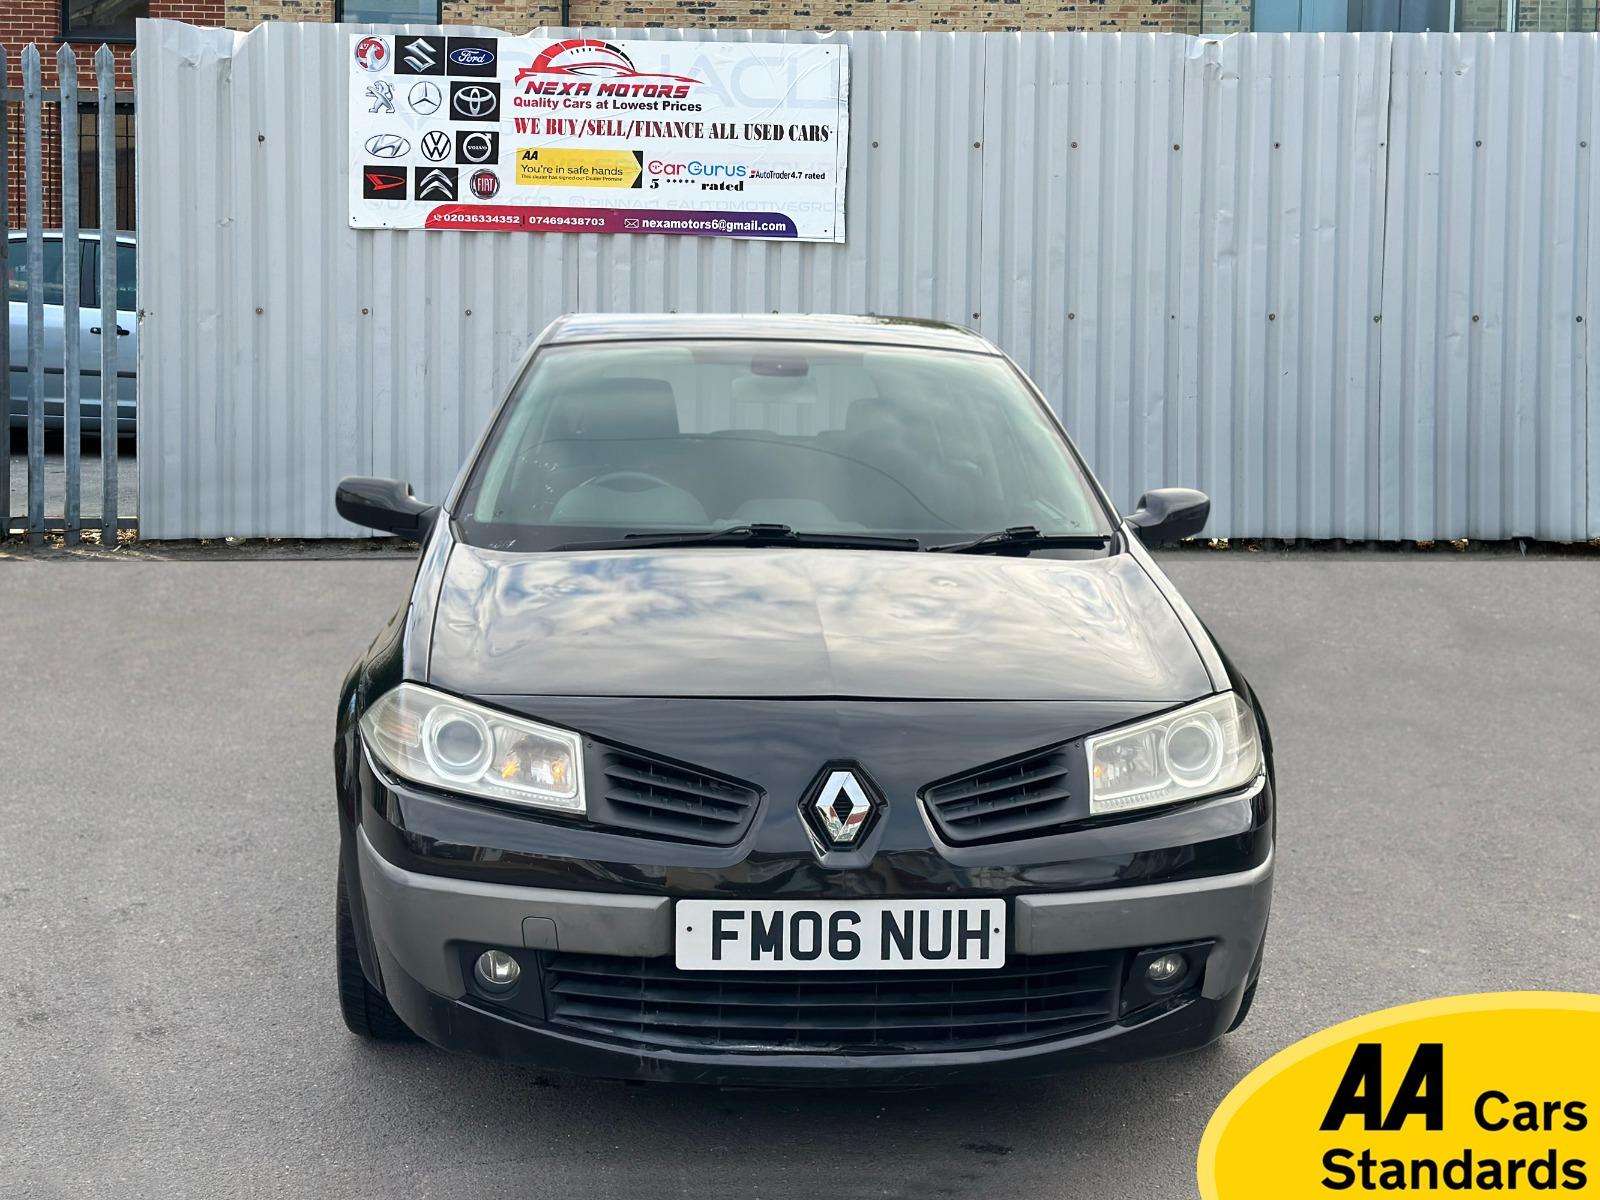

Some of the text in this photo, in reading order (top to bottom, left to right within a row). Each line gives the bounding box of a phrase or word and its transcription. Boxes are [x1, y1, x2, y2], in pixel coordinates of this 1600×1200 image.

[458, 50, 486, 63] Ford
[524, 81, 690, 98] NEXA MOTORS
[513, 97, 702, 112] Quality Cars at Lowest Prices
[513, 117, 829, 142] WE BUY/SELL/FINANCE ALL USED CARS
[521, 150, 539, 161] AA
[521, 165, 623, 176] You're in safe hands
[648, 160, 747, 177] CarGurus
[755, 171, 826, 180] AutoTrader 4.7 rated
[477, 177, 494, 192] FIAT
[649, 178, 745, 192] 5 rated
[443, 213, 605, 226] 02036334352 07469438703
[641, 218, 787, 233] nexamotors6@gmail.com
[711, 909, 990, 962] FM06 NUH
